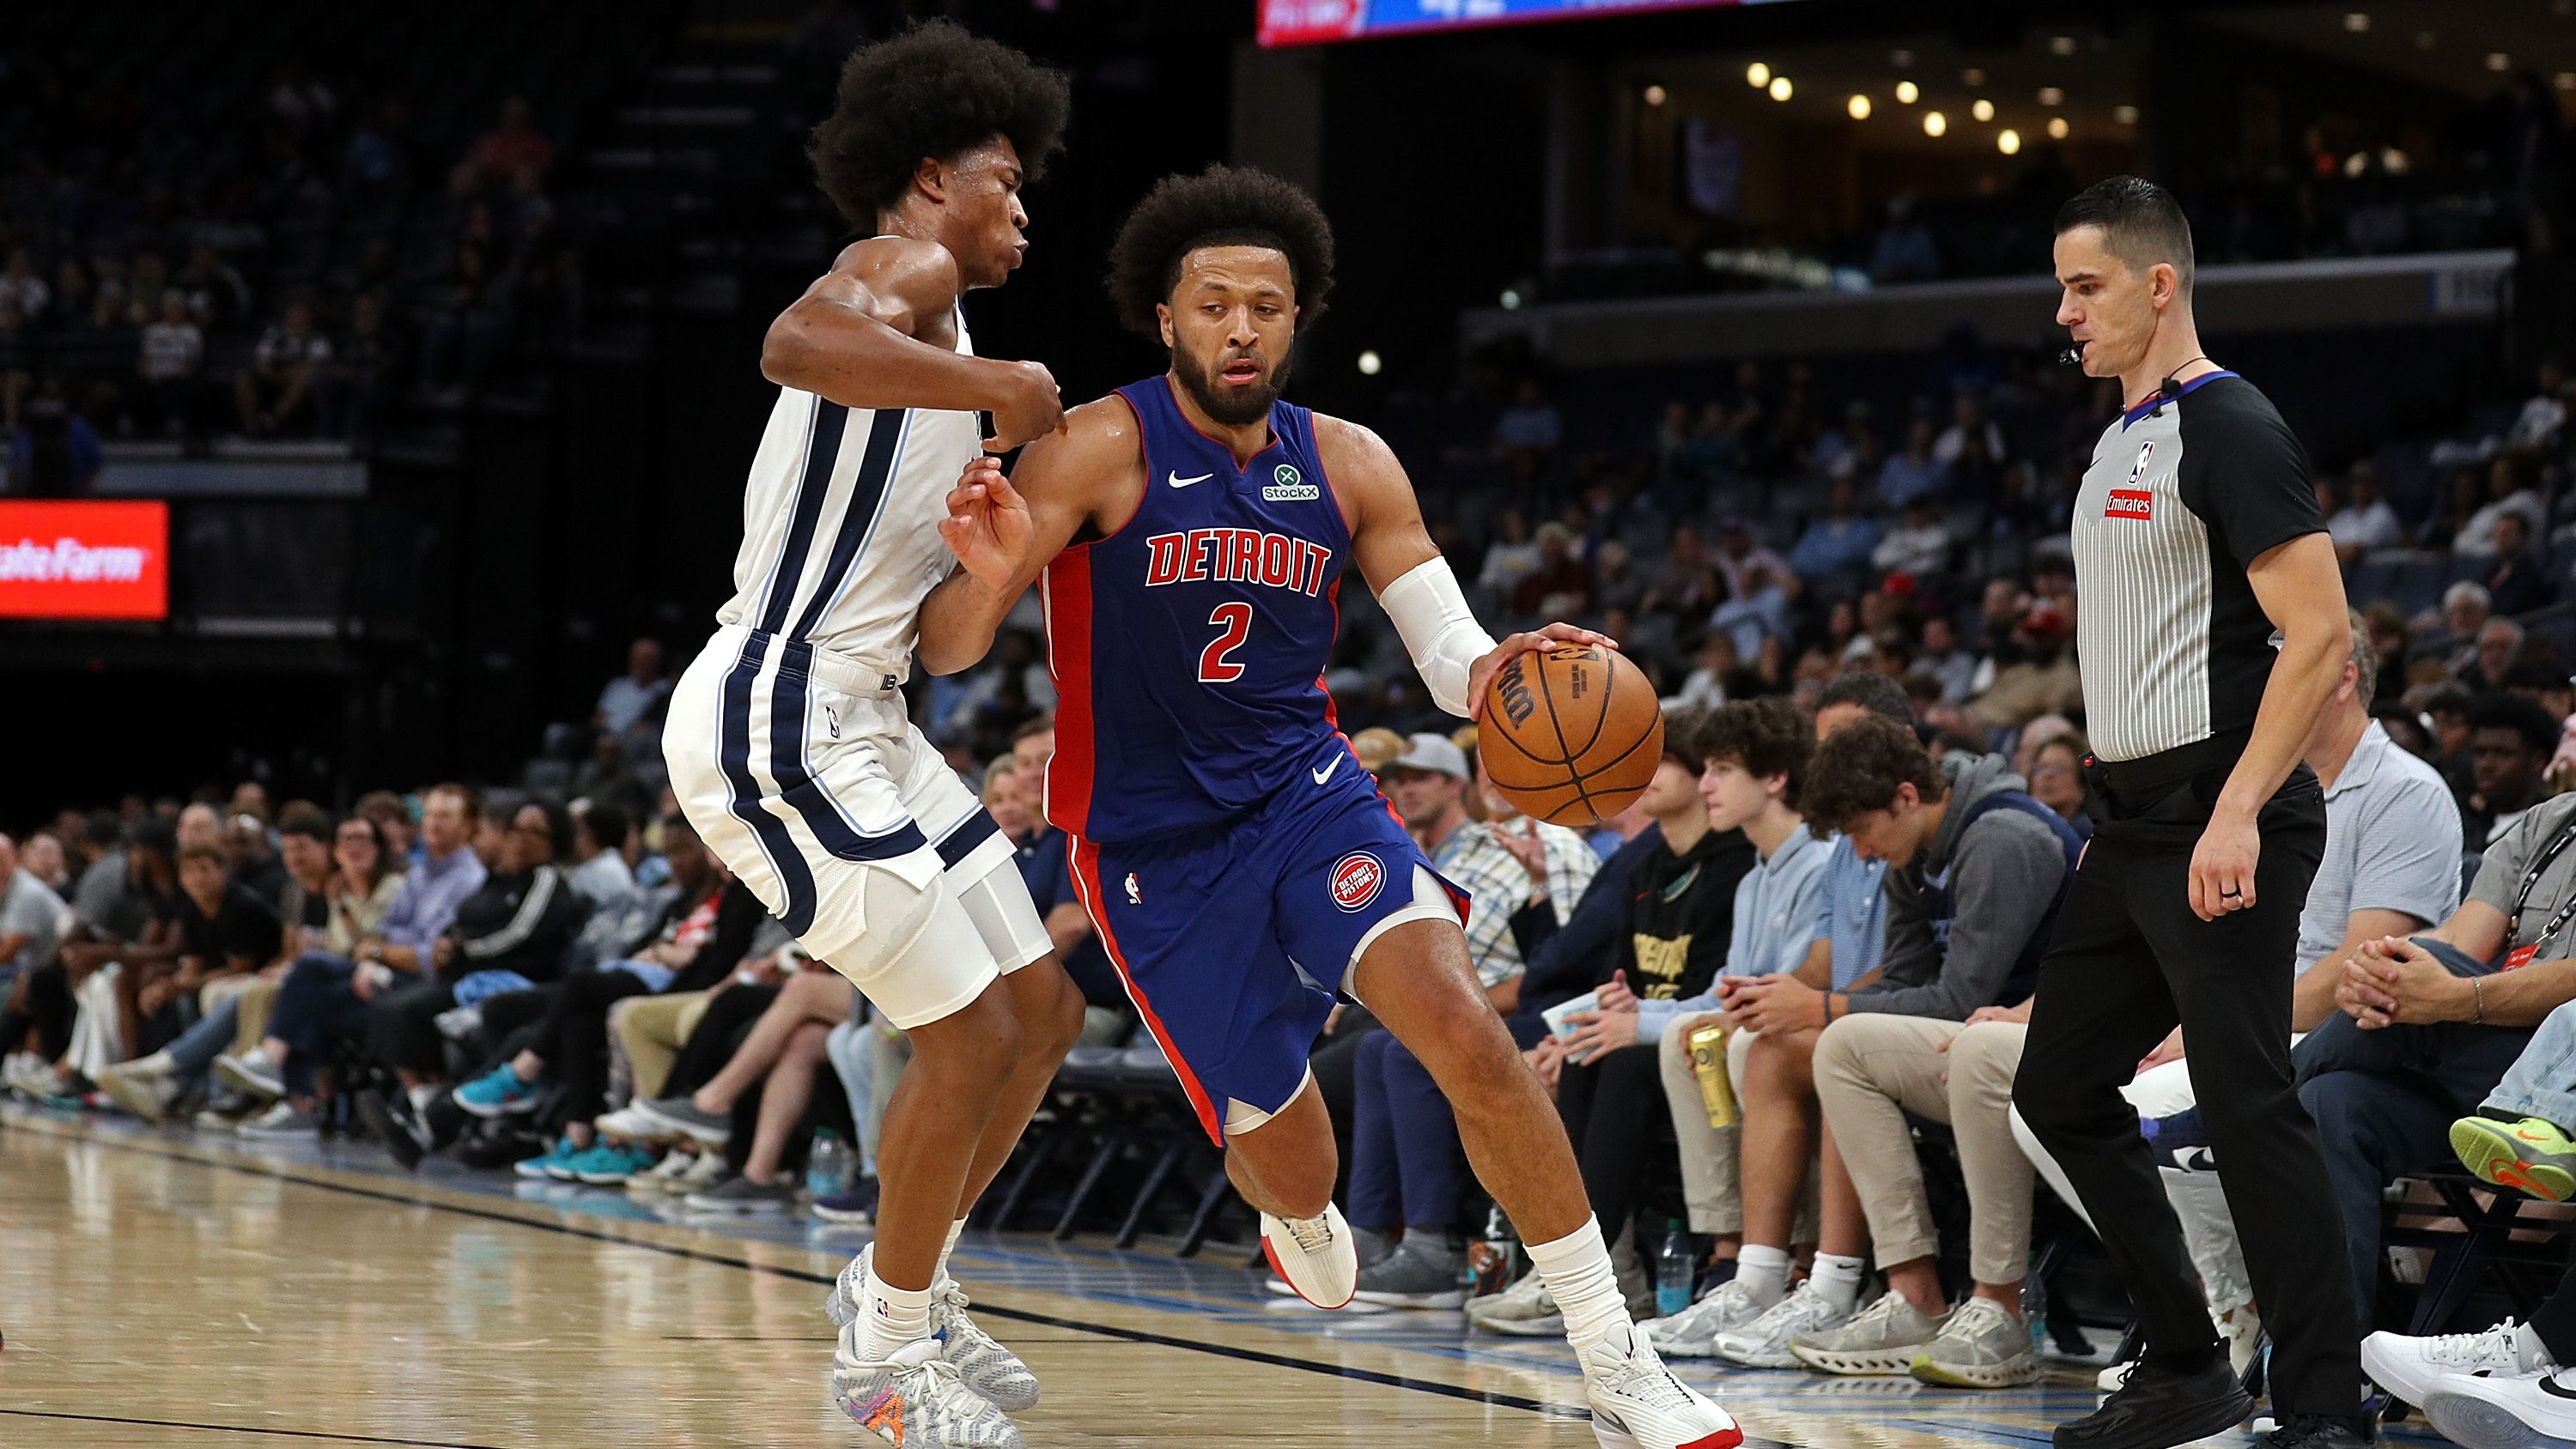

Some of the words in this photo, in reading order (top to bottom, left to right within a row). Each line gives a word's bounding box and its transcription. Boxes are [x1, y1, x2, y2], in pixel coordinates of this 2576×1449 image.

[1264, 487, 1317, 498] StockX
[2106, 494, 2150, 513] Emirates
[1145, 528, 1332, 597] DETROIT
[1198, 602, 1253, 683] 2
[1338, 863, 1370, 890] DETROIT
[1341, 870, 1375, 899] PISTONS
